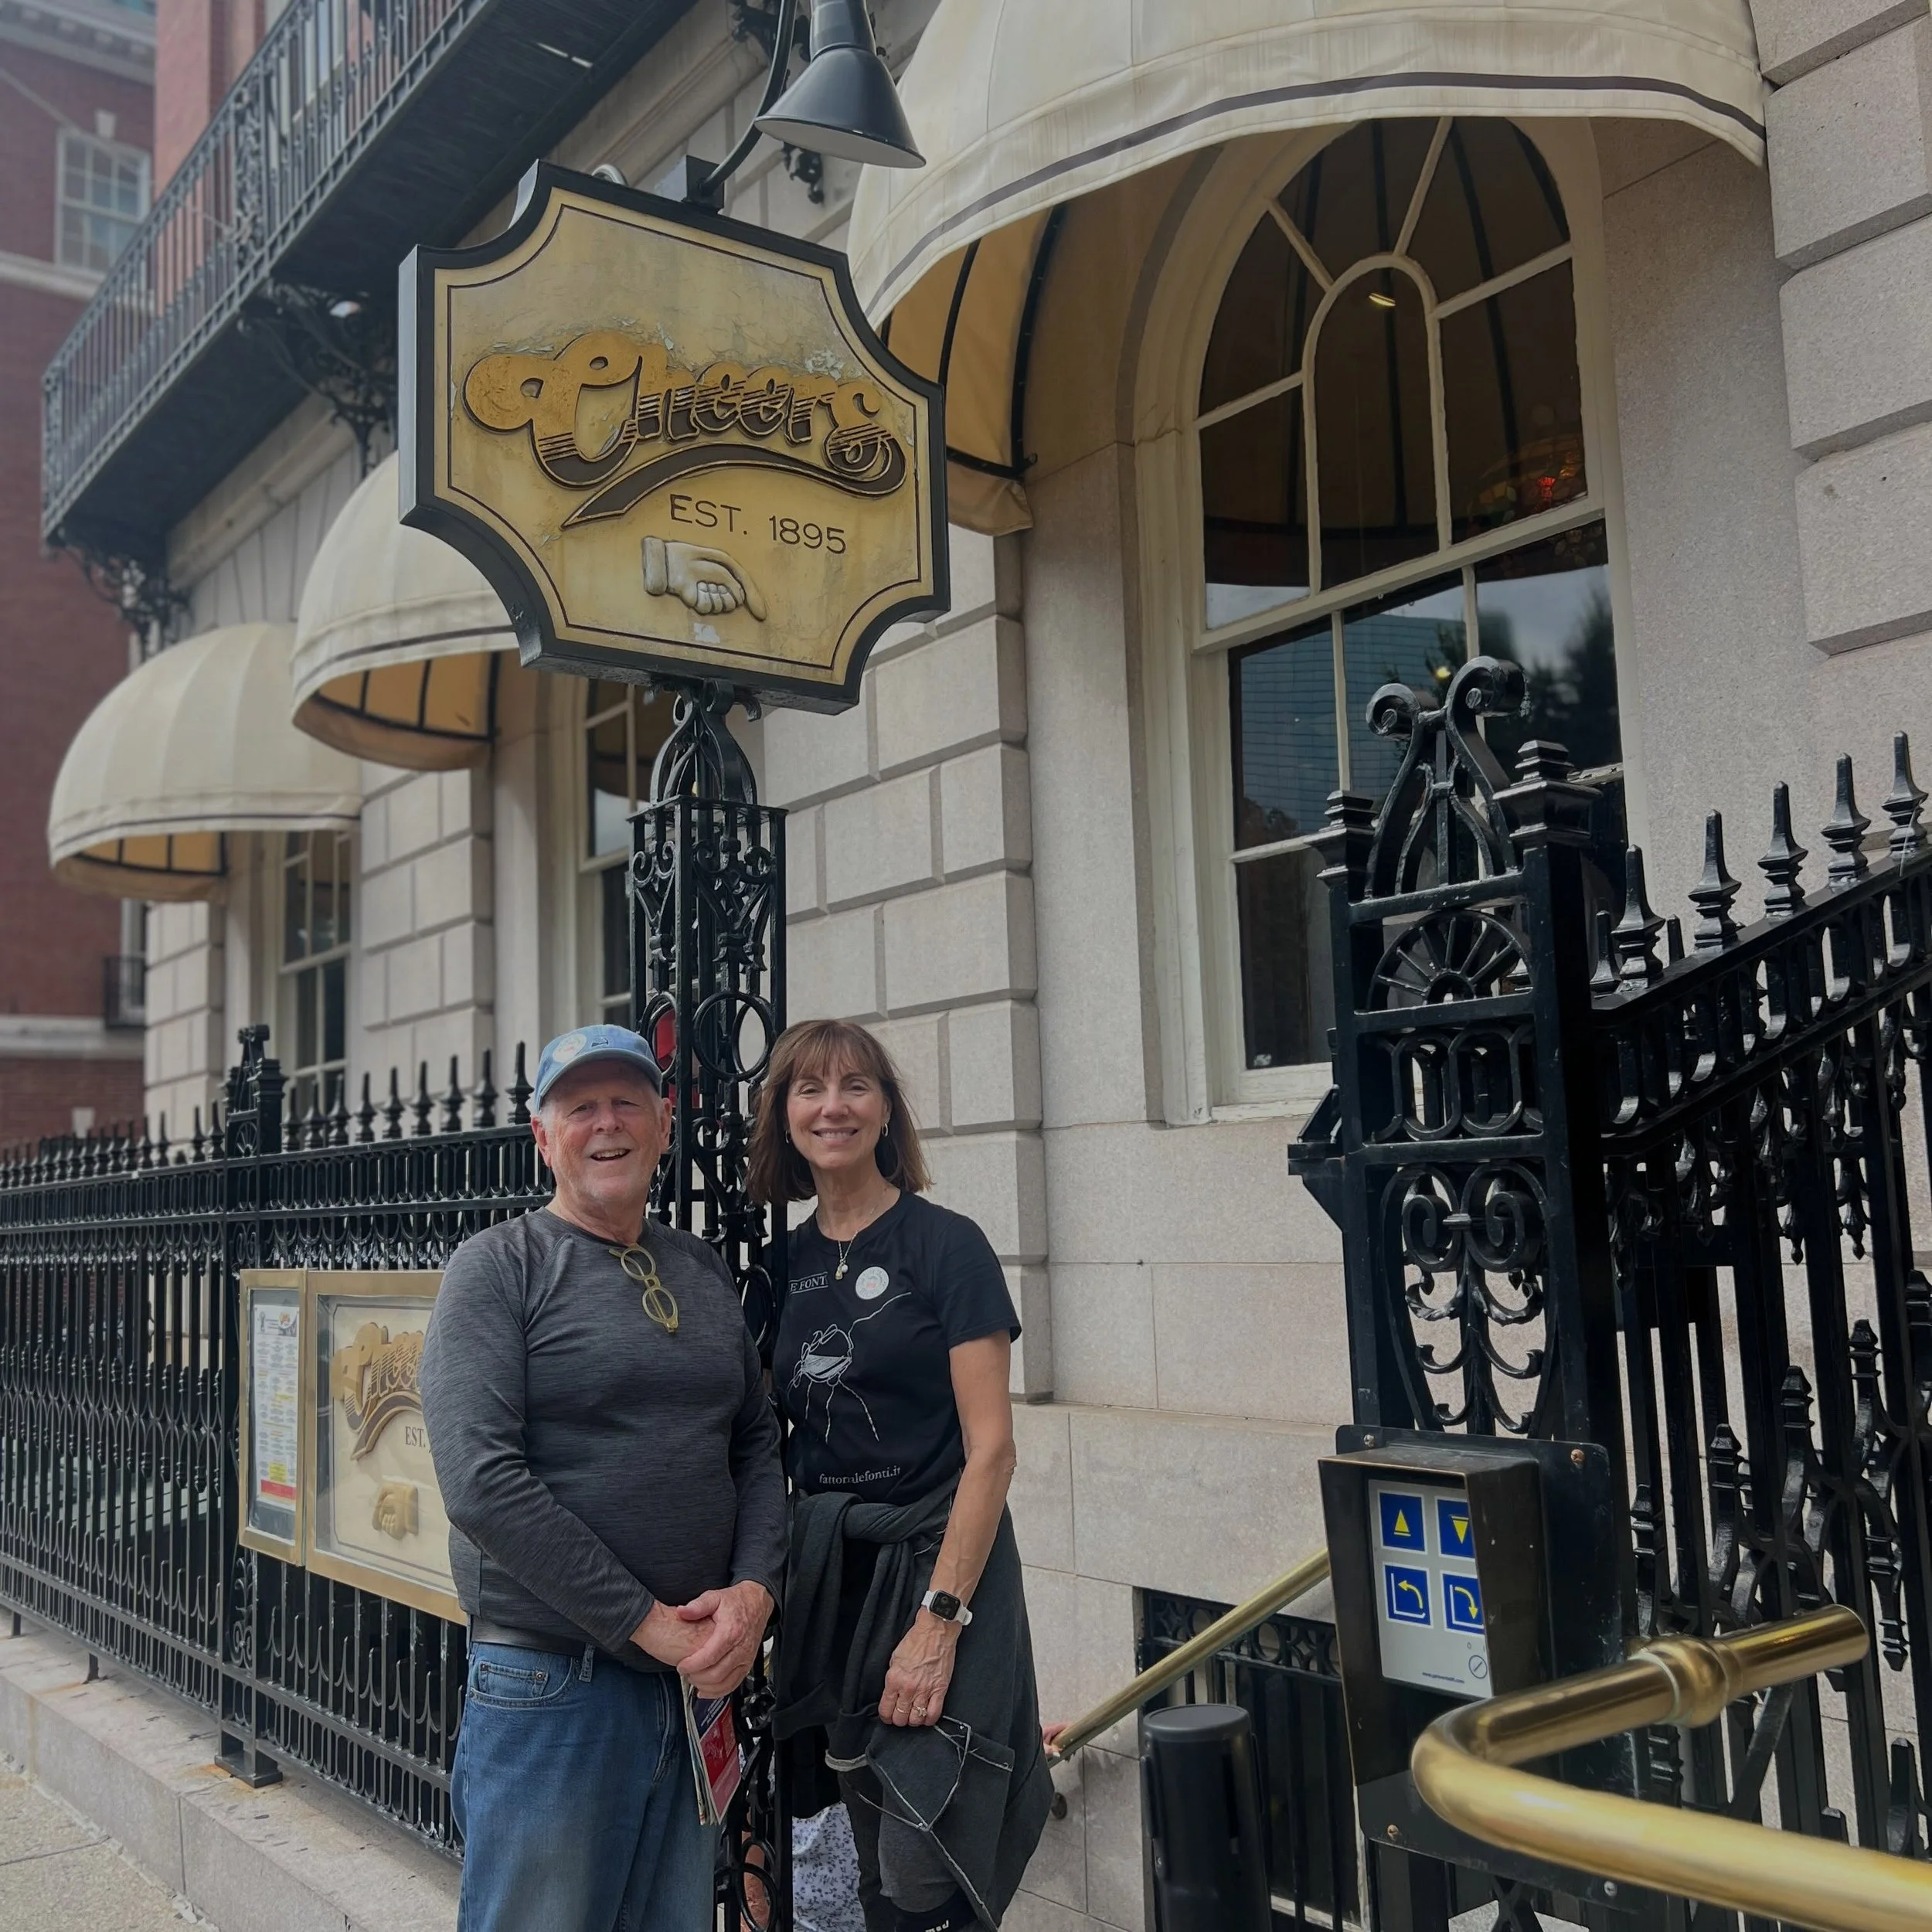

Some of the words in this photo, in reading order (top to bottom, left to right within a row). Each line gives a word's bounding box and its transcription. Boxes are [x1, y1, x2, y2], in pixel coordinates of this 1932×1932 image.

[464, 330, 906, 496] Cheers
[669, 493, 748, 536] EST.
[769, 515, 847, 554] 1895
[332, 1322, 424, 1435] Chee
[405, 1426, 426, 1447] EST.
